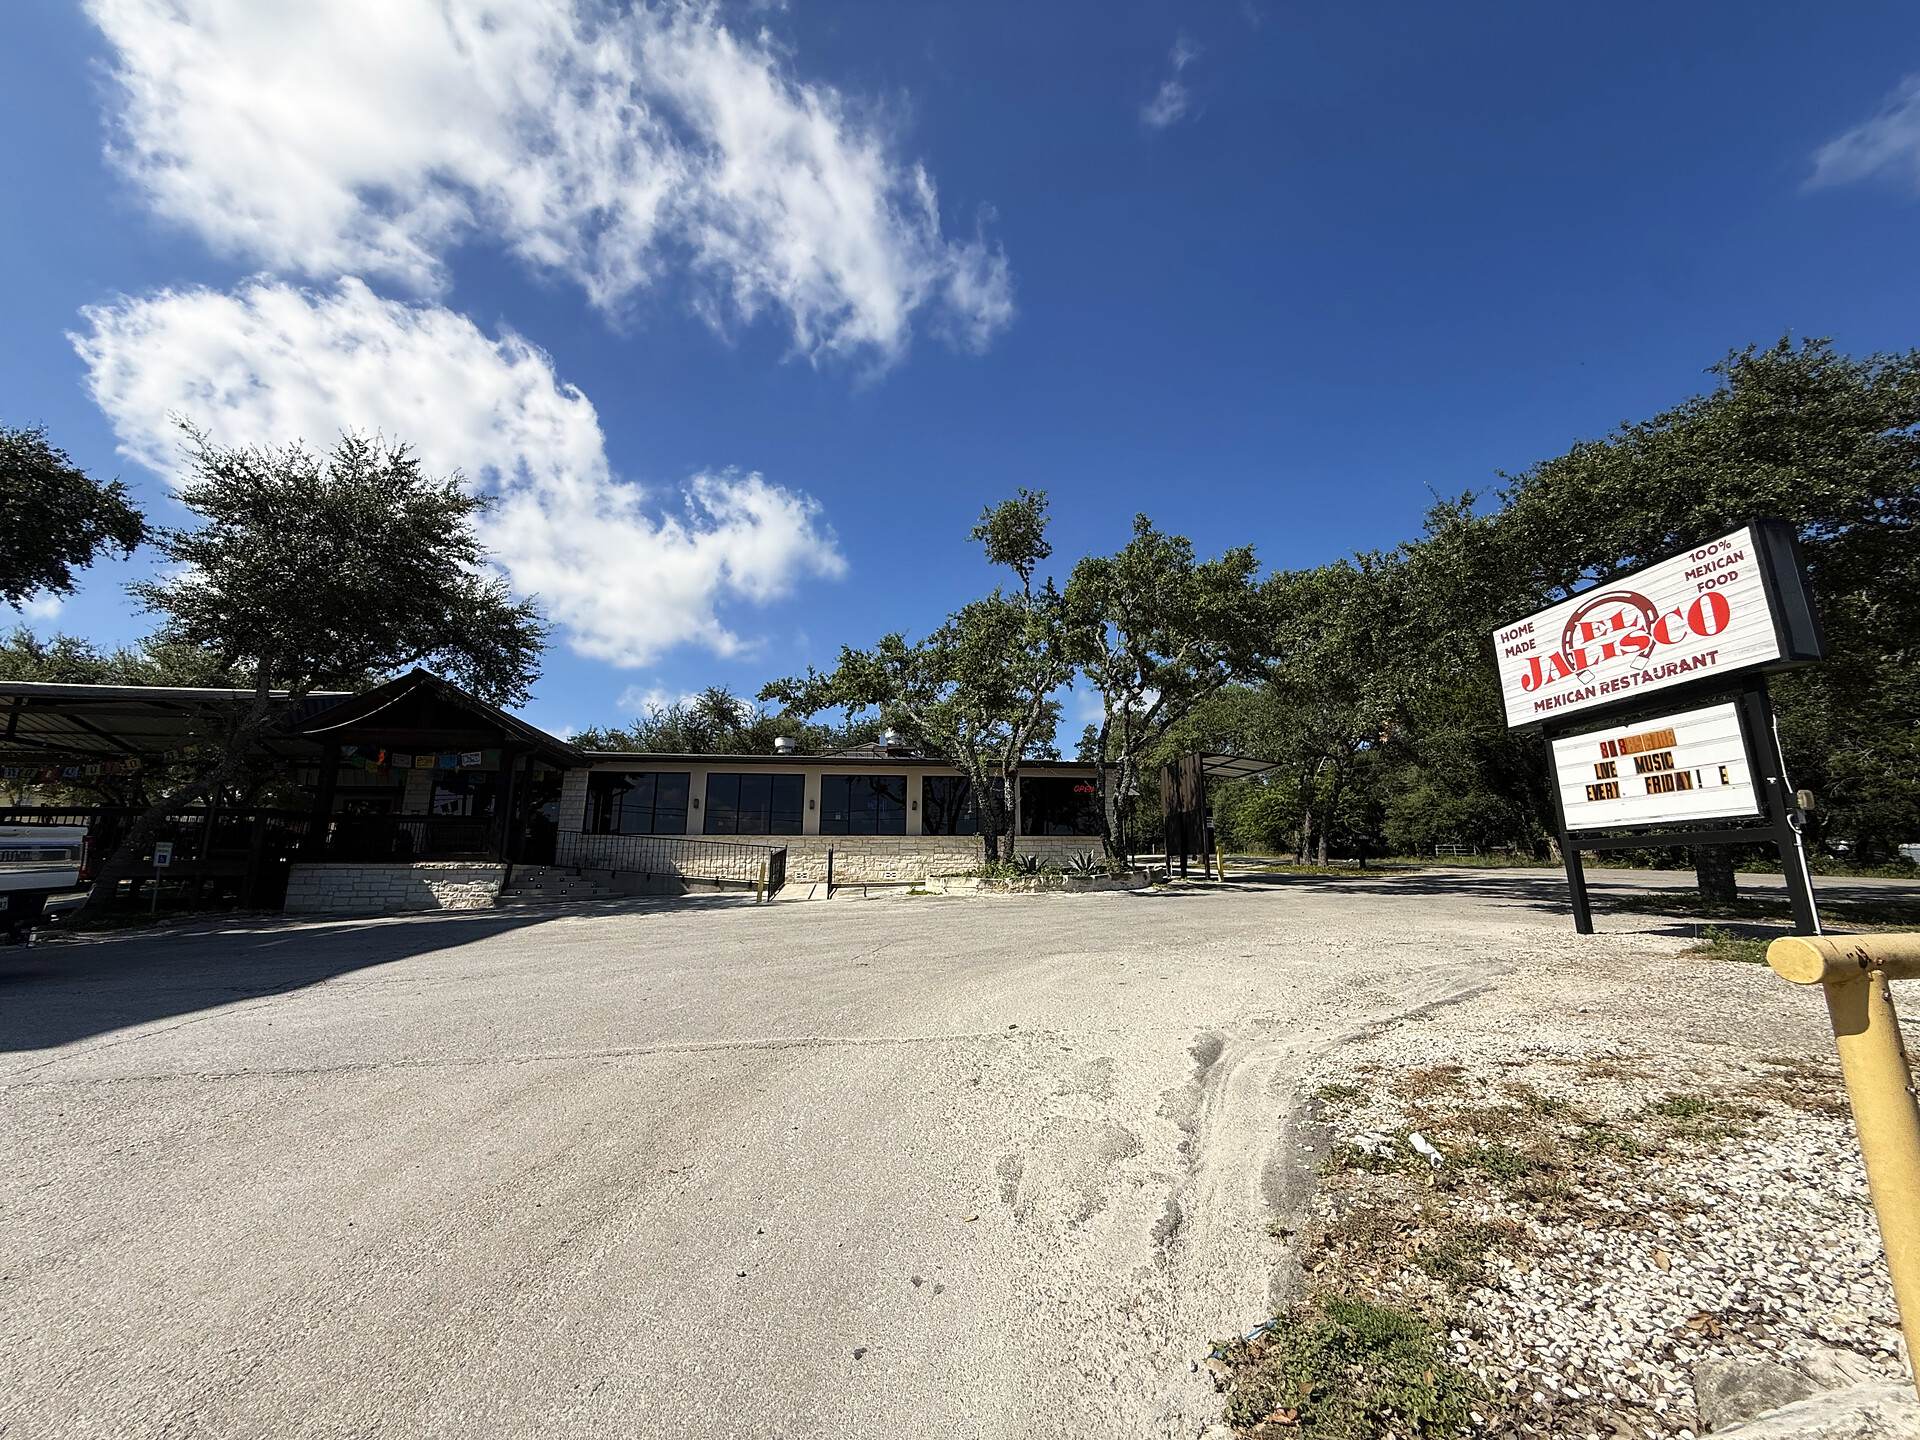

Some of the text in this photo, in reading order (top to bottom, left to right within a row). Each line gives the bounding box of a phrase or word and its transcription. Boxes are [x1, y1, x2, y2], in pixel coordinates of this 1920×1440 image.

[1689, 540, 1731, 562] 100%
[1685, 550, 1744, 581] MEXICAN
[1697, 570, 1739, 593] FOOD
[1501, 622, 1534, 643] HOME
[1580, 608, 1640, 643] EL
[1505, 638, 1536, 658] MADE
[1521, 592, 1730, 692] JALISCO
[1534, 651, 1718, 713] MEXICAN RESTAURANT
[1594, 751, 1675, 780] LIVE MUSIC
[1585, 781, 1620, 802] EVERY
